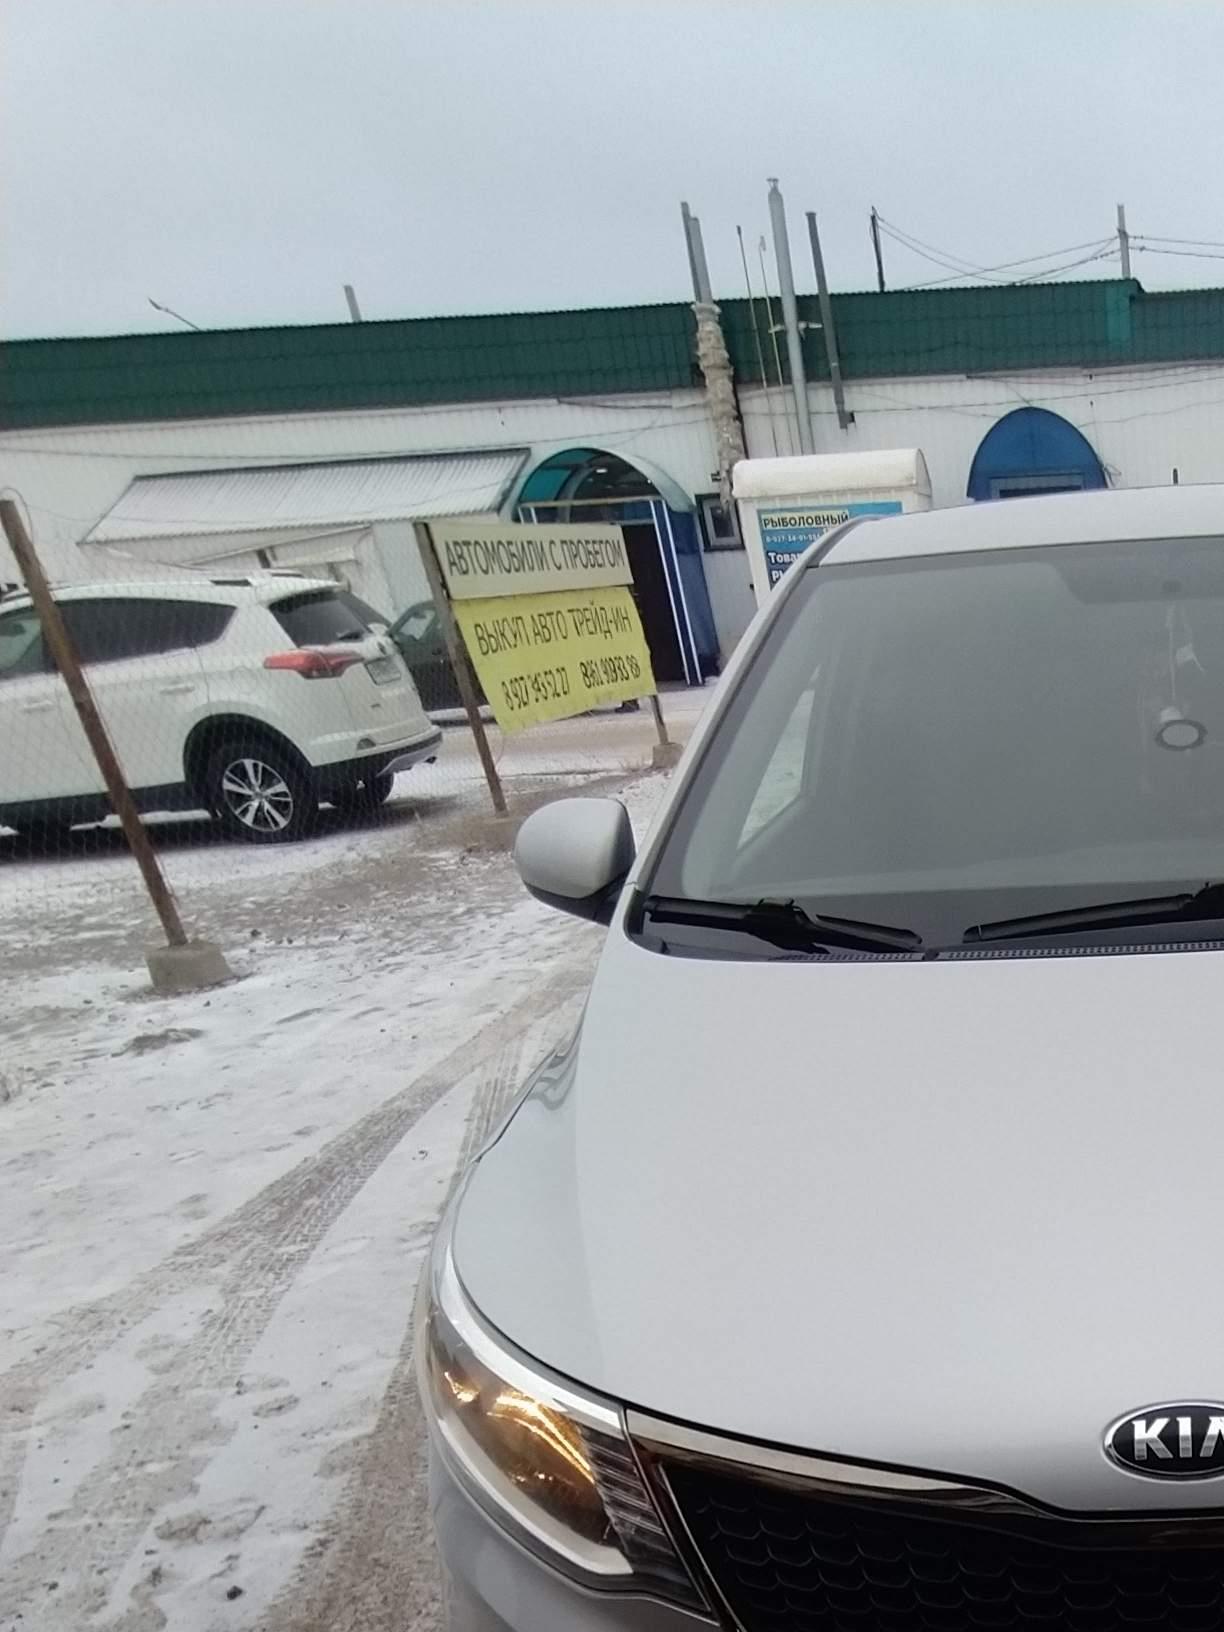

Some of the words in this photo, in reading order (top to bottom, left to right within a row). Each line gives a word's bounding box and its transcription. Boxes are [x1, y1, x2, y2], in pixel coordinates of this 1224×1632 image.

[763, 511, 849, 529] РЫБОЛОВНЫЙ
[444, 539, 546, 576] АВТОМОБИЛИ
[550, 541, 562, 570] С
[561, 539, 625, 571] ПРОБЕГОМ
[474, 615, 531, 656] ВЫКУП
[530, 609, 568, 647] АВТО
[567, 600, 633, 640] ТРЕЙД-ИН
